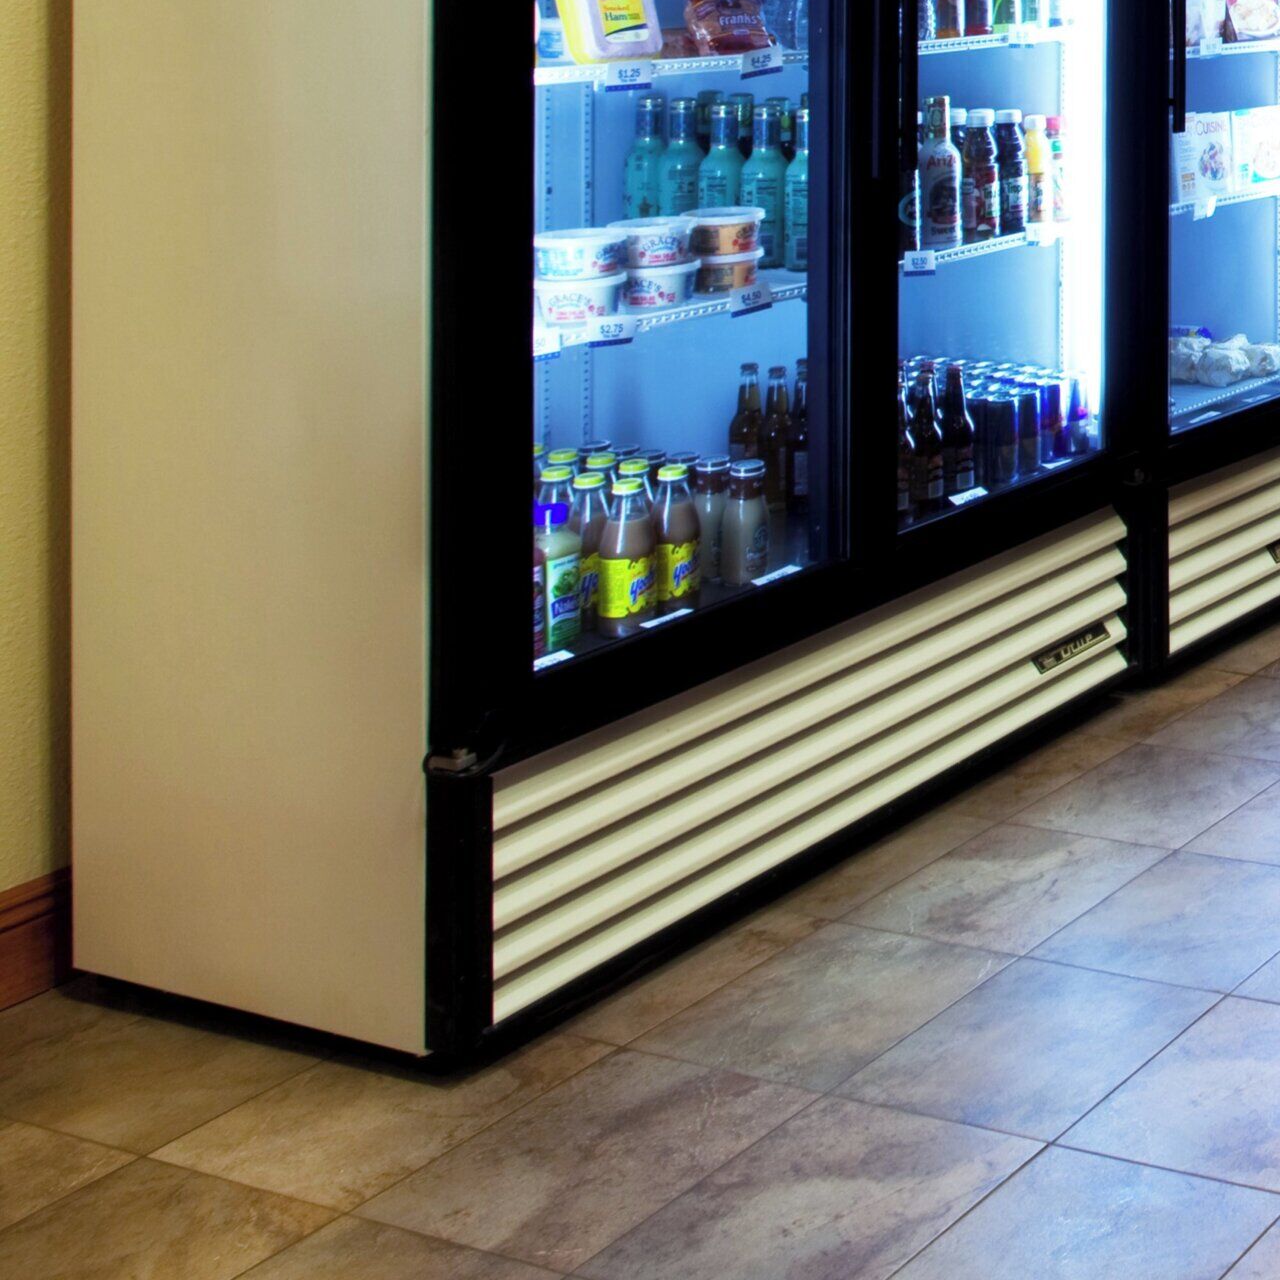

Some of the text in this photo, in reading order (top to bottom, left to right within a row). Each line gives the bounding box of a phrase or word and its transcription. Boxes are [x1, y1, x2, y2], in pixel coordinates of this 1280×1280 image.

[604, 11, 628, 22] Ham
[719, 14, 759, 26] Franks
[617, 68, 641, 79] $1.25
[600, 323, 624, 335] $2.75
